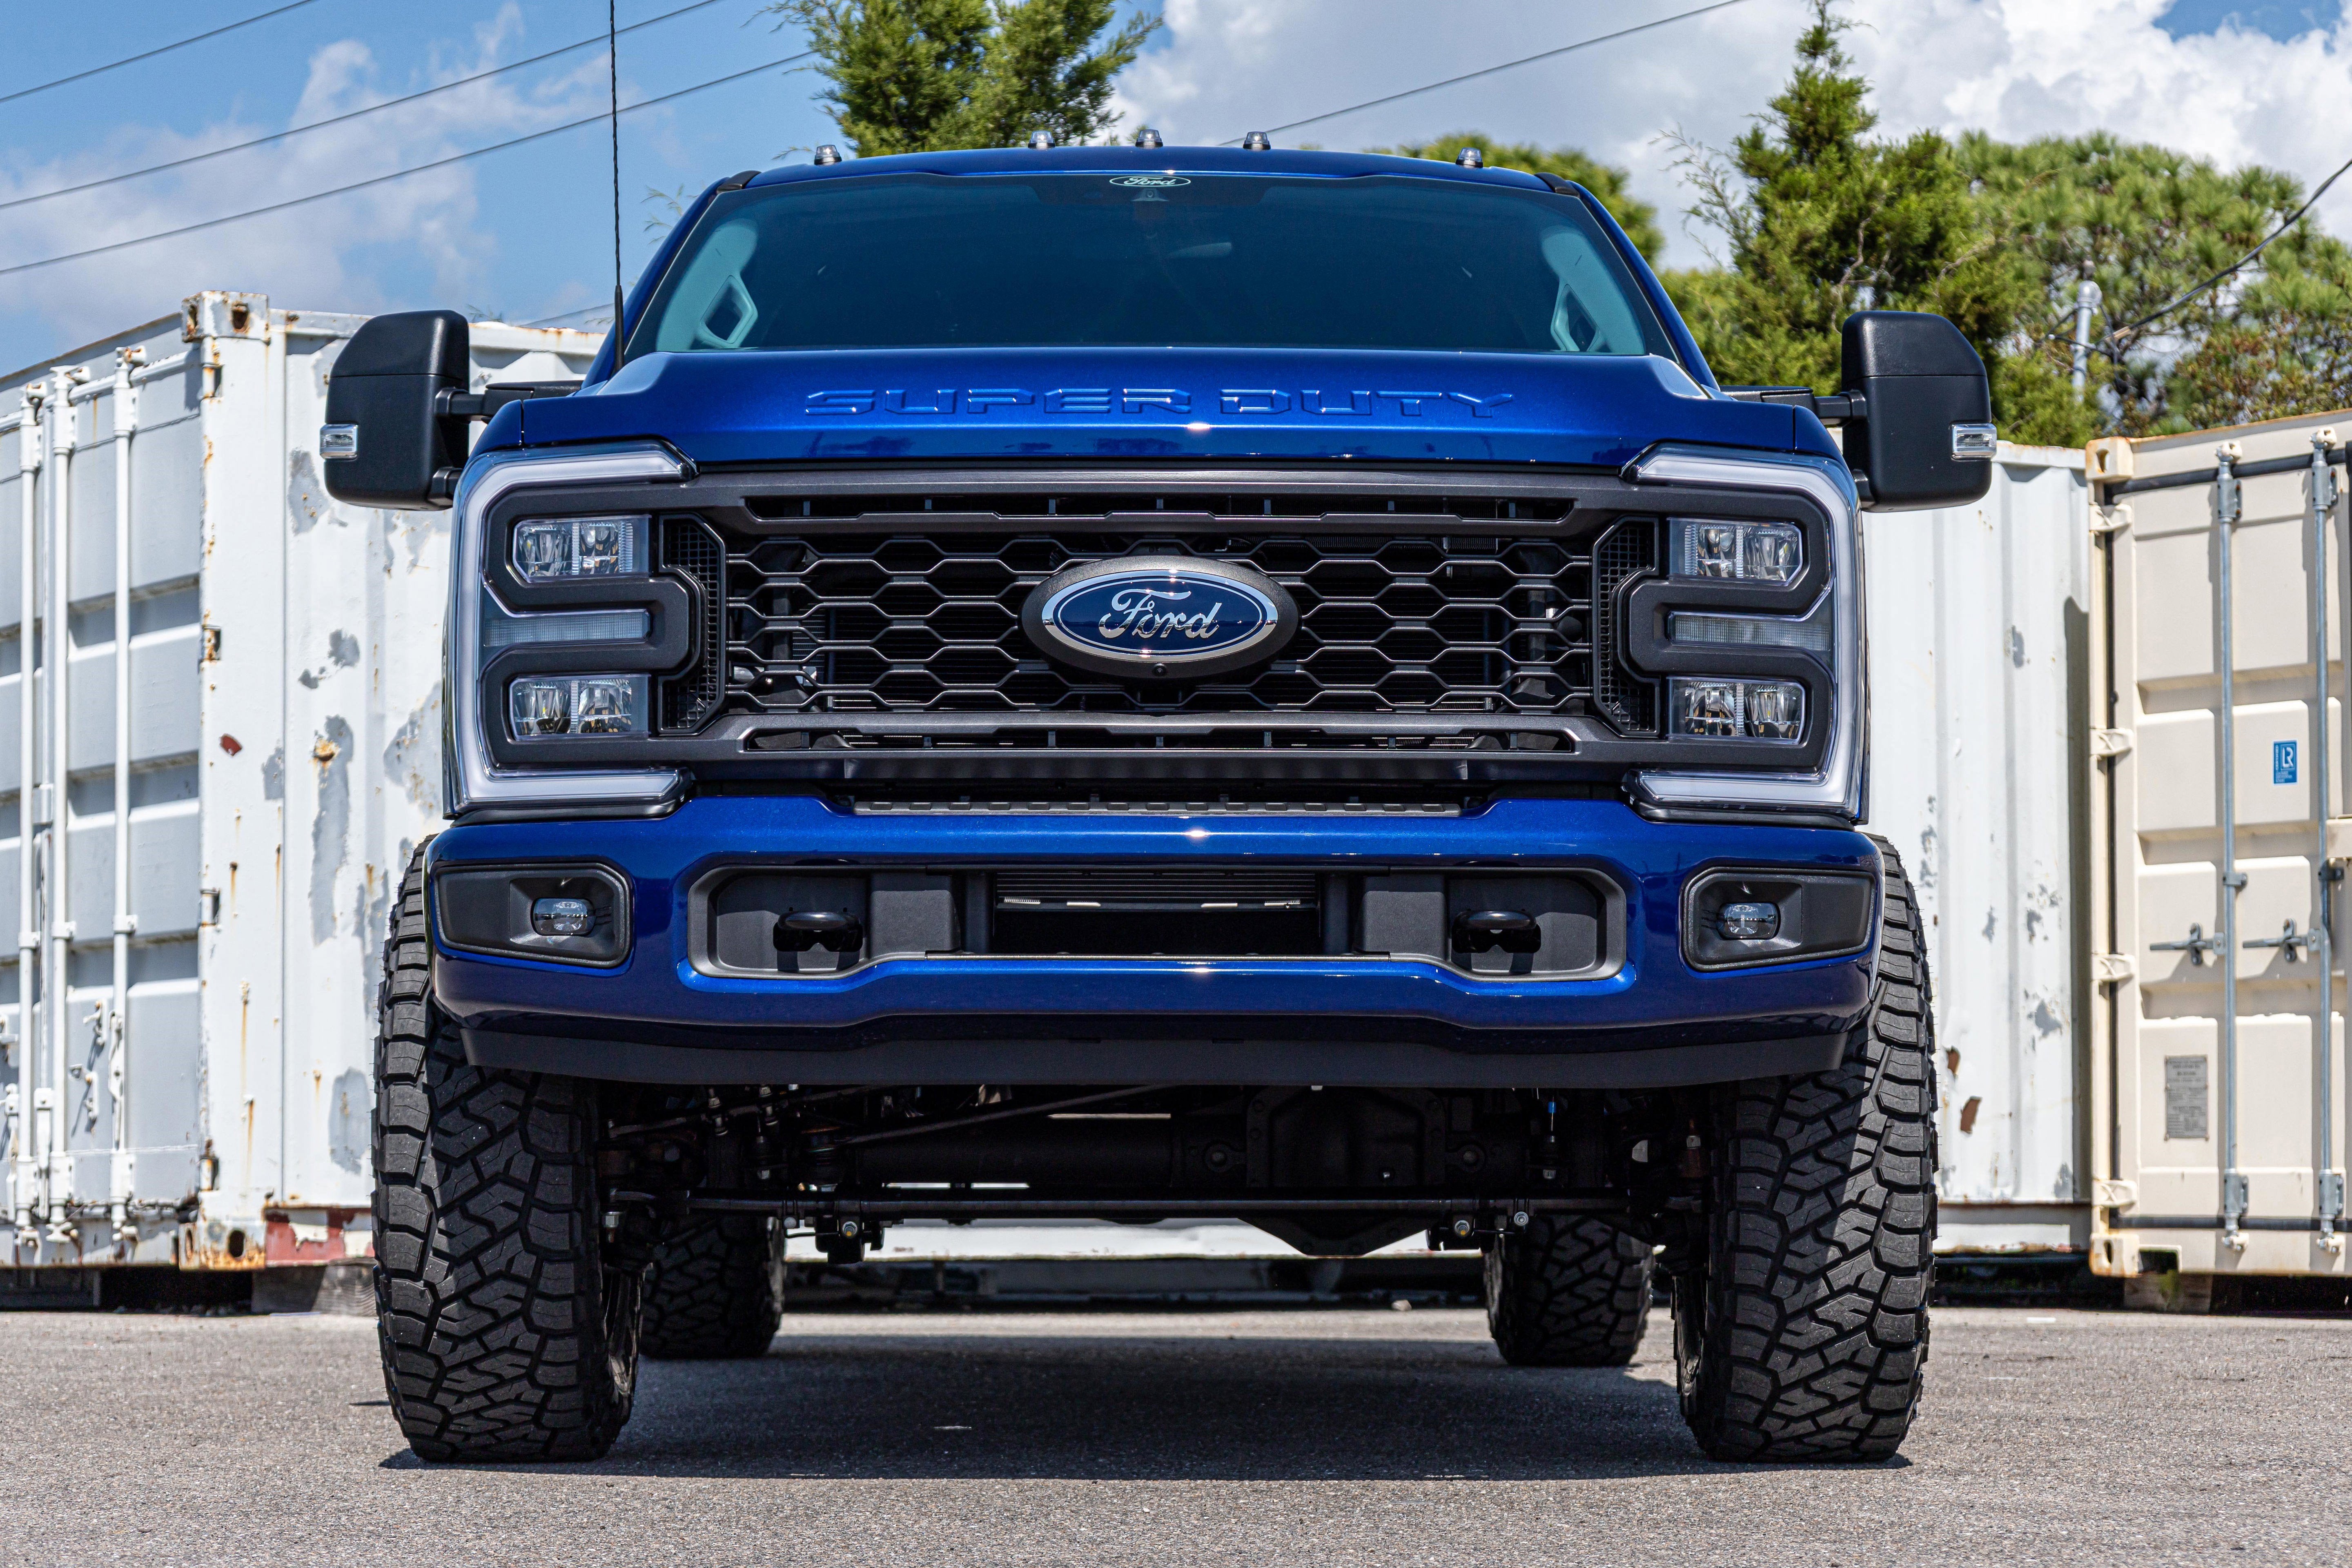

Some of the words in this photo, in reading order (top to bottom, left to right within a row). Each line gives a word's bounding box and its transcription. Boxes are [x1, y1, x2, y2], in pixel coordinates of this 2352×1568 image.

[1124, 176, 1176, 185] Ford
[805, 389, 1191, 414] SUPER
[1220, 389, 1512, 417] DUTY
[1098, 589, 1222, 638] Ford
